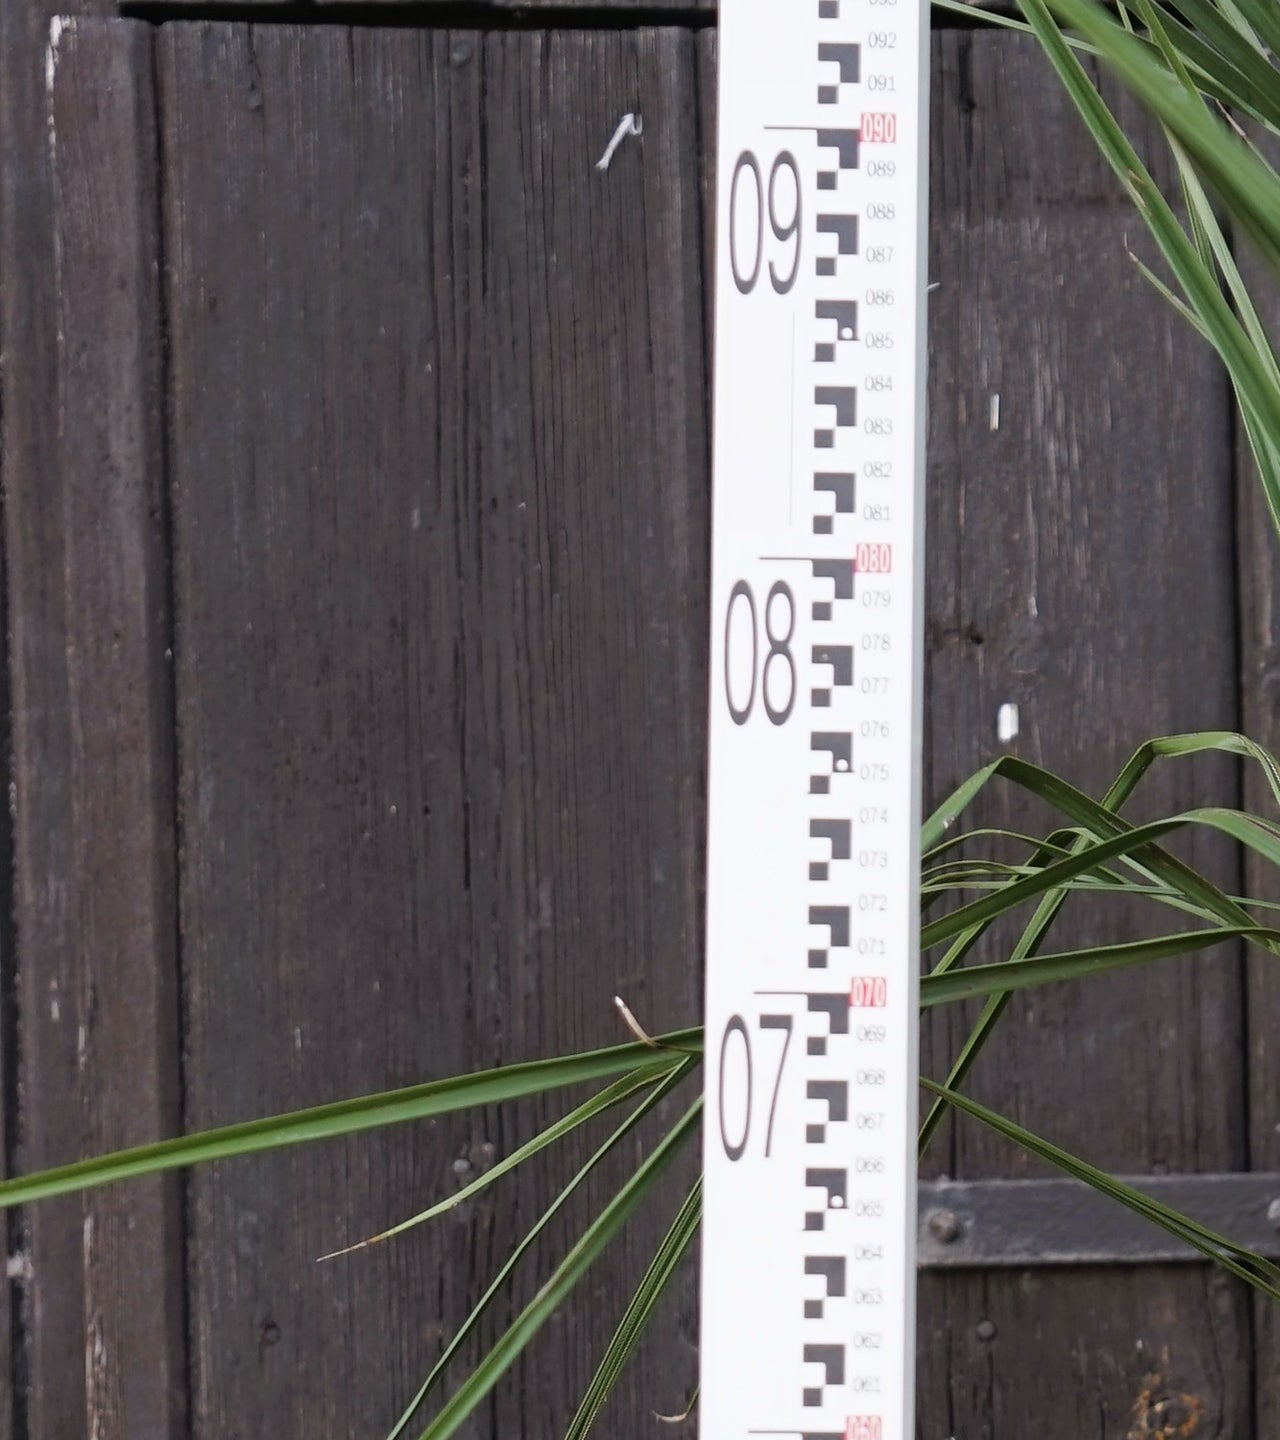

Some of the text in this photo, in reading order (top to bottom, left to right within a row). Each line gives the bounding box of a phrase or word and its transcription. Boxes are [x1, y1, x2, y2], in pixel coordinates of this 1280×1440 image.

[867, 31, 897, 49] 092
[867, 74, 896, 92] 091
[861, 115, 895, 141] 090
[866, 160, 897, 178] 089
[866, 203, 896, 221] 088
[730, 149, 801, 295] 09
[865, 246, 894, 264] 087
[865, 290, 895, 306] 086
[864, 332, 895, 349] 085
[864, 375, 893, 392] 084
[863, 417, 893, 436] 083
[863, 461, 893, 479] 082
[862, 504, 891, 522] 081
[857, 545, 890, 571] 080
[861, 589, 892, 608] 079
[861, 633, 892, 652] 078
[725, 579, 797, 726] 08
[860, 676, 890, 695] 077
[860, 719, 890, 739] 076
[859, 763, 890, 782] 075
[858, 806, 889, 825] 074
[857, 849, 889, 870] 073
[857, 893, 888, 913] 072
[856, 936, 887, 956] 071
[856, 1025, 887, 1043] 069
[856, 1069, 886, 1086] 068
[719, 1014, 793, 1161] 07
[855, 1111, 885, 1130] 067
[855, 1156, 885, 1174] 066
[854, 1199, 884, 1218] 065
[854, 1244, 884, 1261] 064
[854, 1287, 883, 1305] 063
[853, 1332, 882, 1350] 062
[852, 1376, 881, 1393] 061
